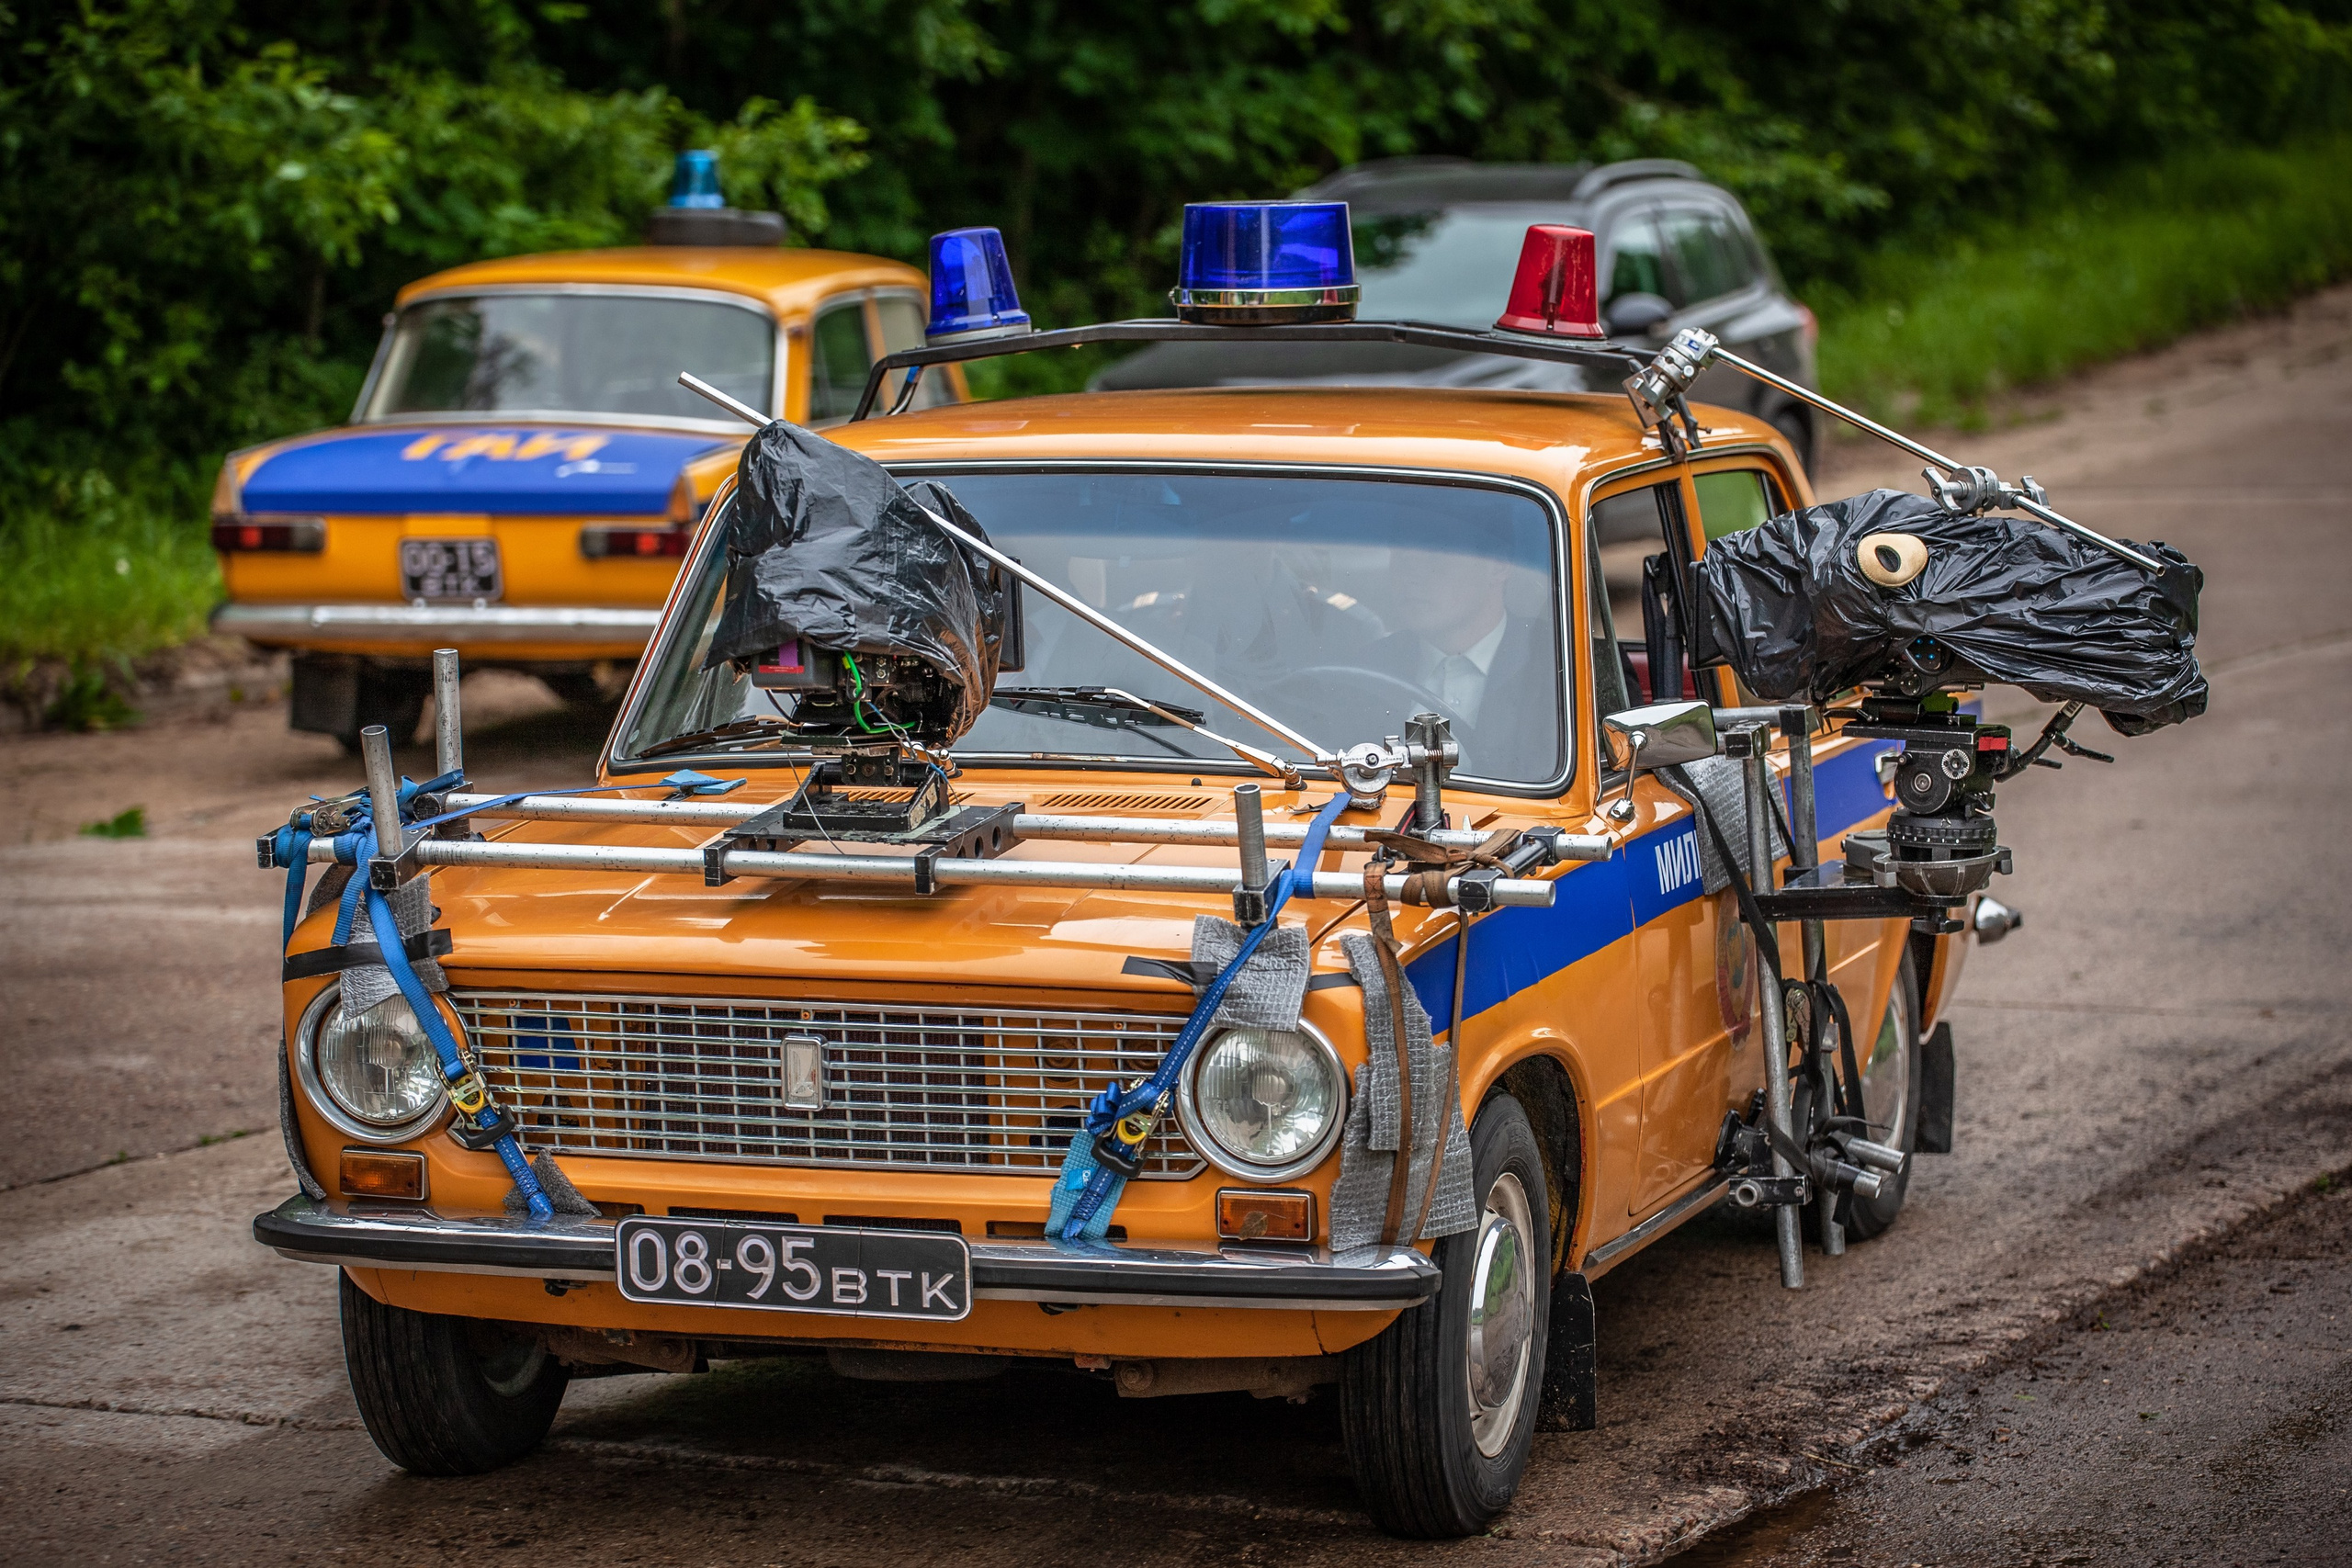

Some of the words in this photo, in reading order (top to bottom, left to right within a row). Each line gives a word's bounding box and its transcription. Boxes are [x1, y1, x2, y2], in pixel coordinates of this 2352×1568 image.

[401, 432, 611, 461] ГАИ
[1655, 829, 1702, 895] МИЛ
[628, 1227, 822, 1301] 08-95
